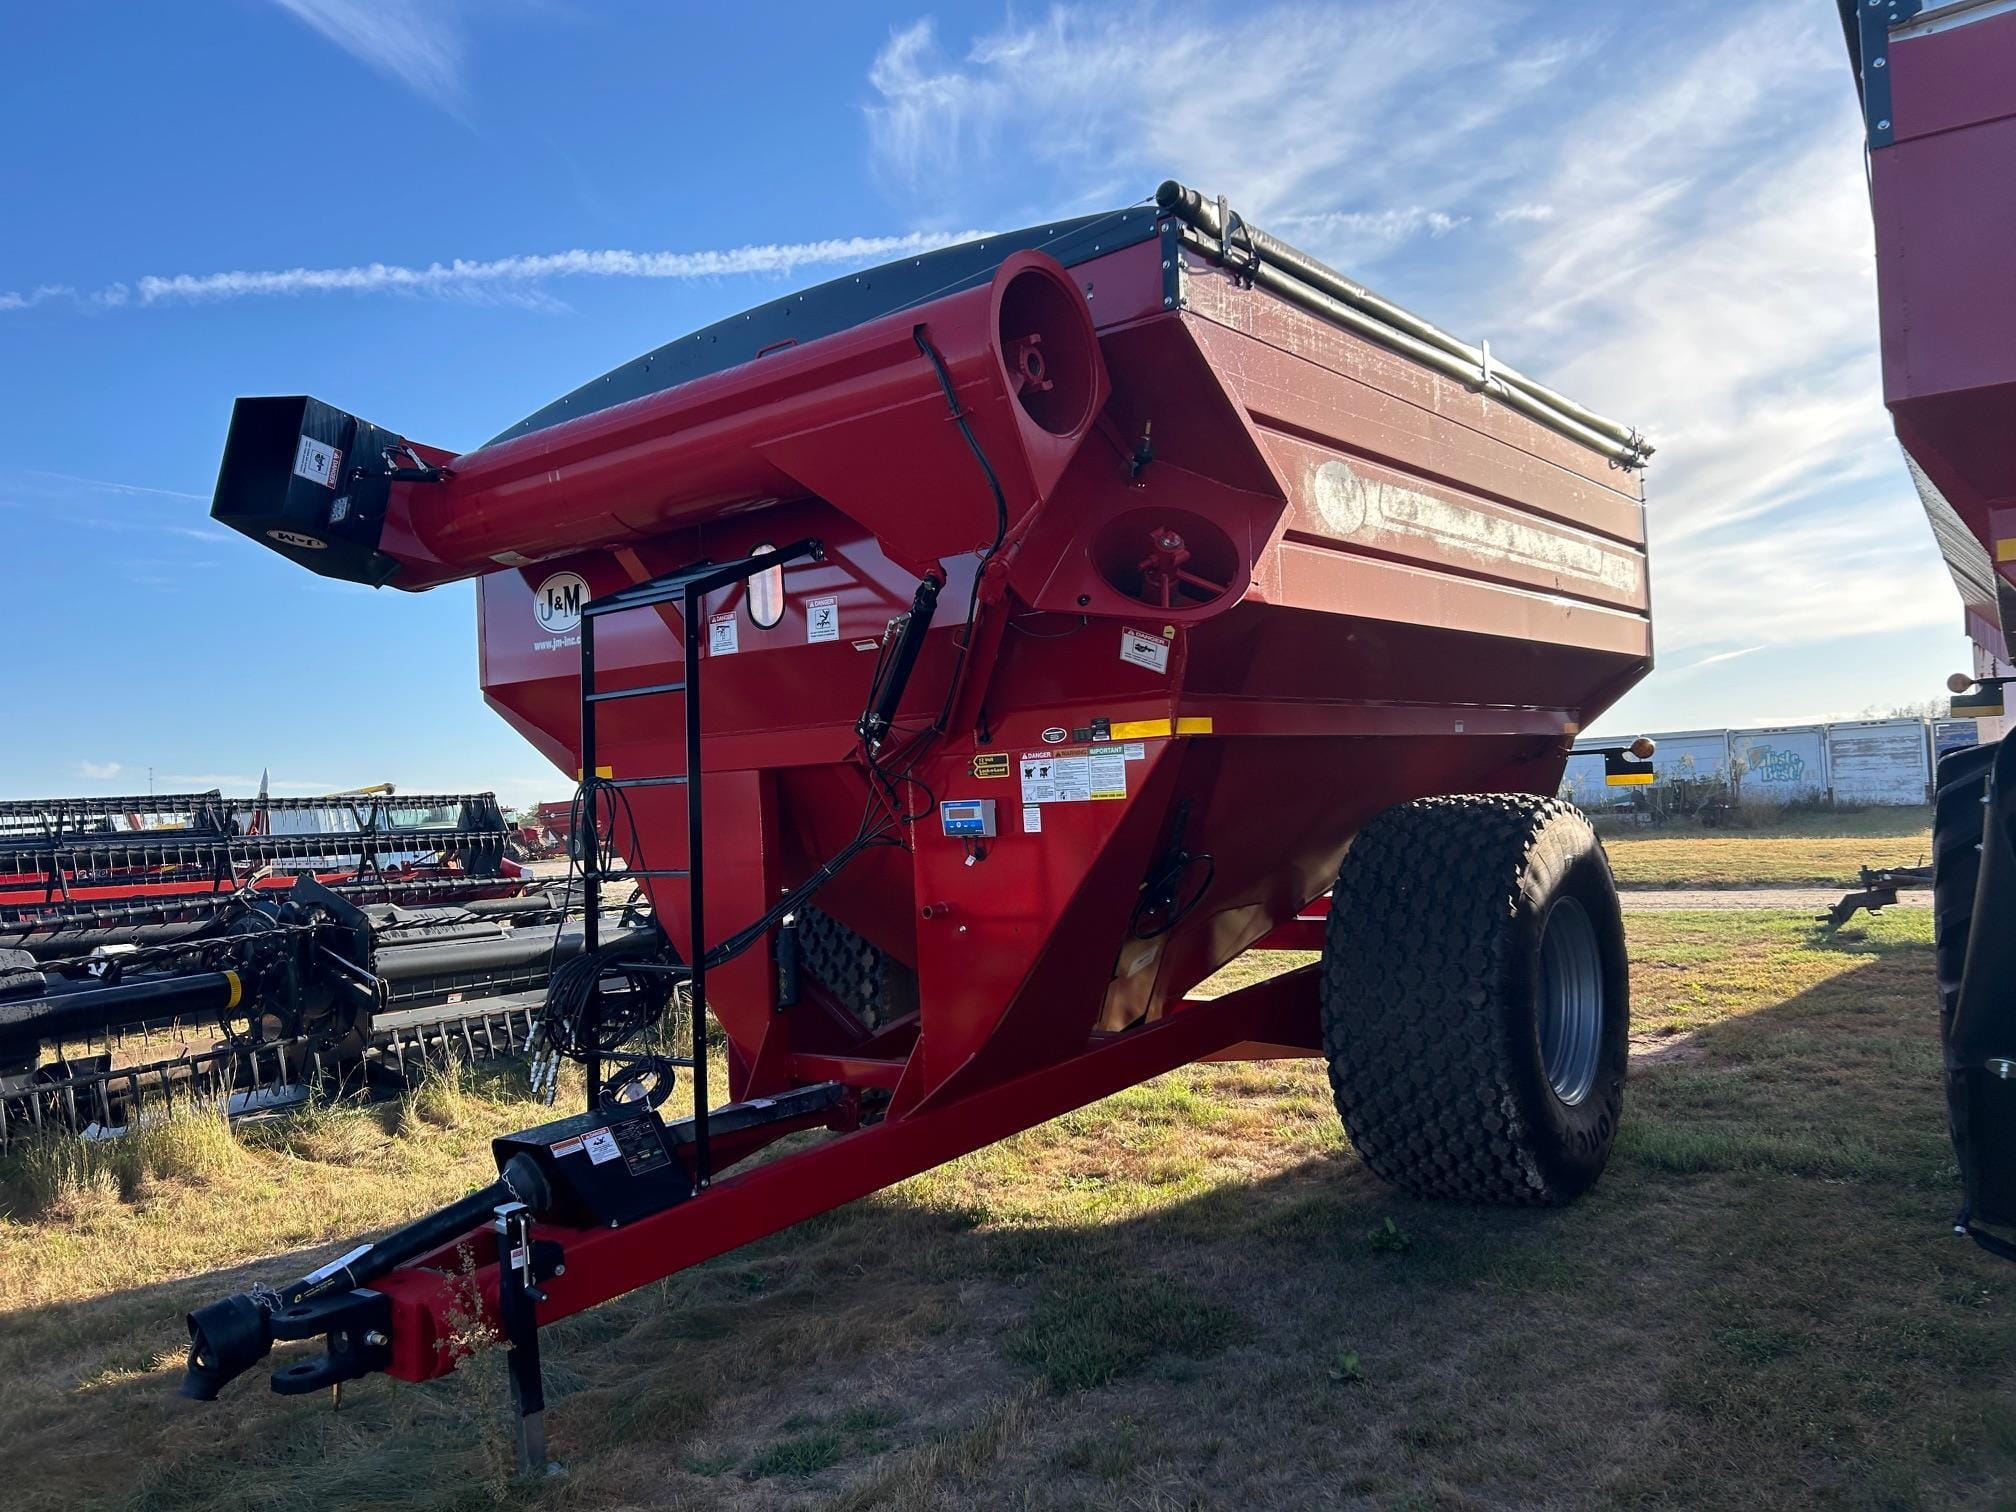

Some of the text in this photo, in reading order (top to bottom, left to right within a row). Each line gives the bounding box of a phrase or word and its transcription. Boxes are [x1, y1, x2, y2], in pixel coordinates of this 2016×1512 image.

[328, 461, 338, 485] DANGER
[539, 583, 581, 621] J&M
[815, 599, 834, 607] DANGER
[716, 613, 734, 622] DANGER
[534, 636, 581, 651] www.jm-inc.c
[1136, 632, 1165, 645] DANGER
[1027, 751, 1052, 759] DANGER
[1090, 746, 1122, 754] IMPORTANT
